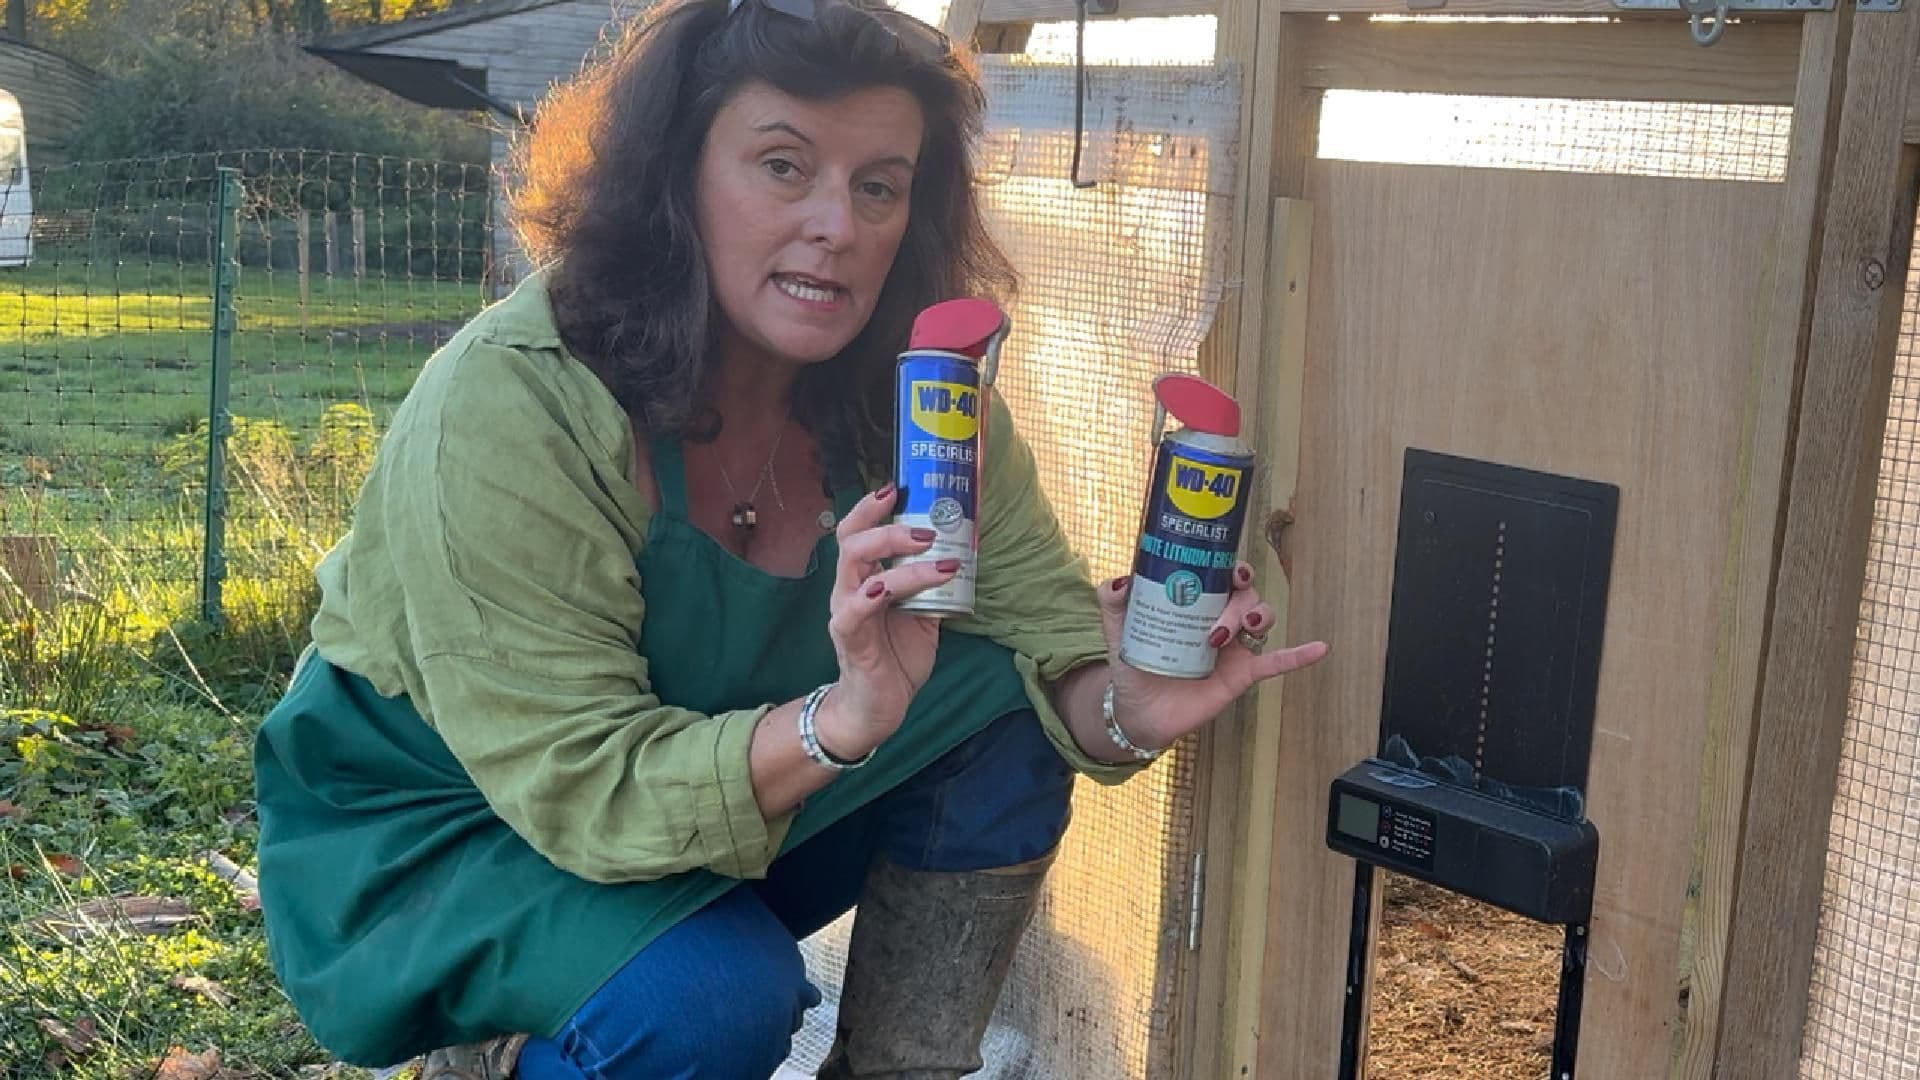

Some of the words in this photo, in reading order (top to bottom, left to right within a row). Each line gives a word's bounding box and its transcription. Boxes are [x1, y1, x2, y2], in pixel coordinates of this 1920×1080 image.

[919, 386, 977, 418] WD-40
[911, 443, 976, 463] SPECIALIS
[1176, 464, 1235, 497] WD-40
[1161, 515, 1230, 540] SPECIALIST
[1163, 541, 1212, 568] LITHIUM
